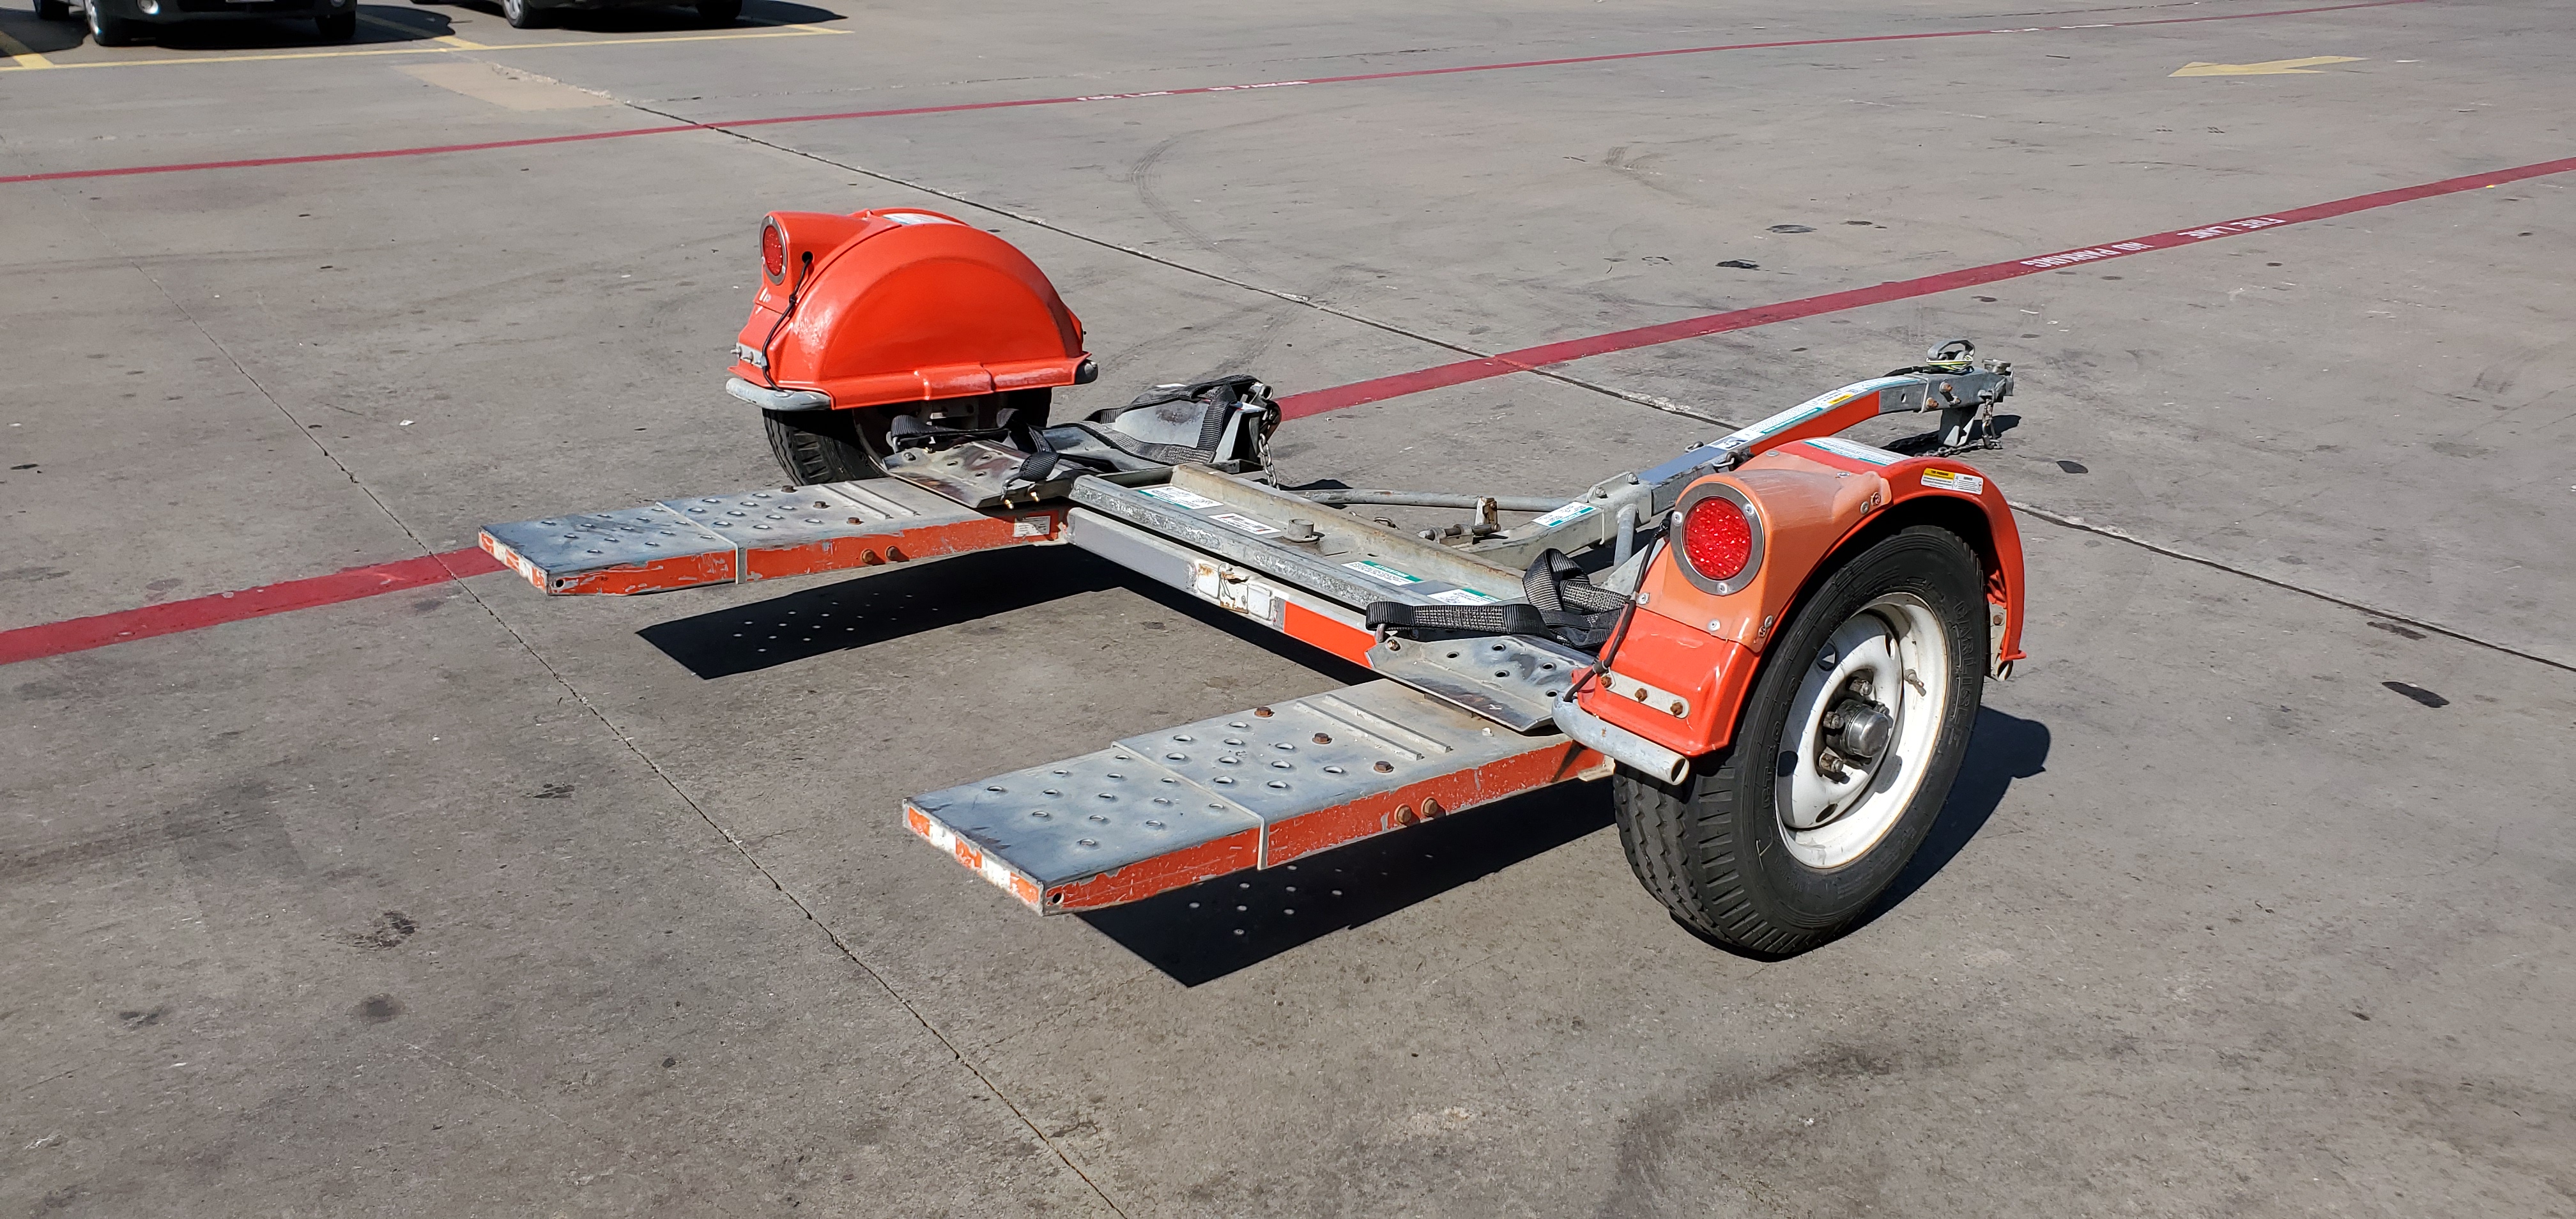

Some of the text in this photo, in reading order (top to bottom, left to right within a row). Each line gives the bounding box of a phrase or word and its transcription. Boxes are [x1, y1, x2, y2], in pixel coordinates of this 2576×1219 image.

[2019, 217, 2287, 268] FIRE LANE NO PARKING
[1949, 600, 1974, 748] CARLISLE
